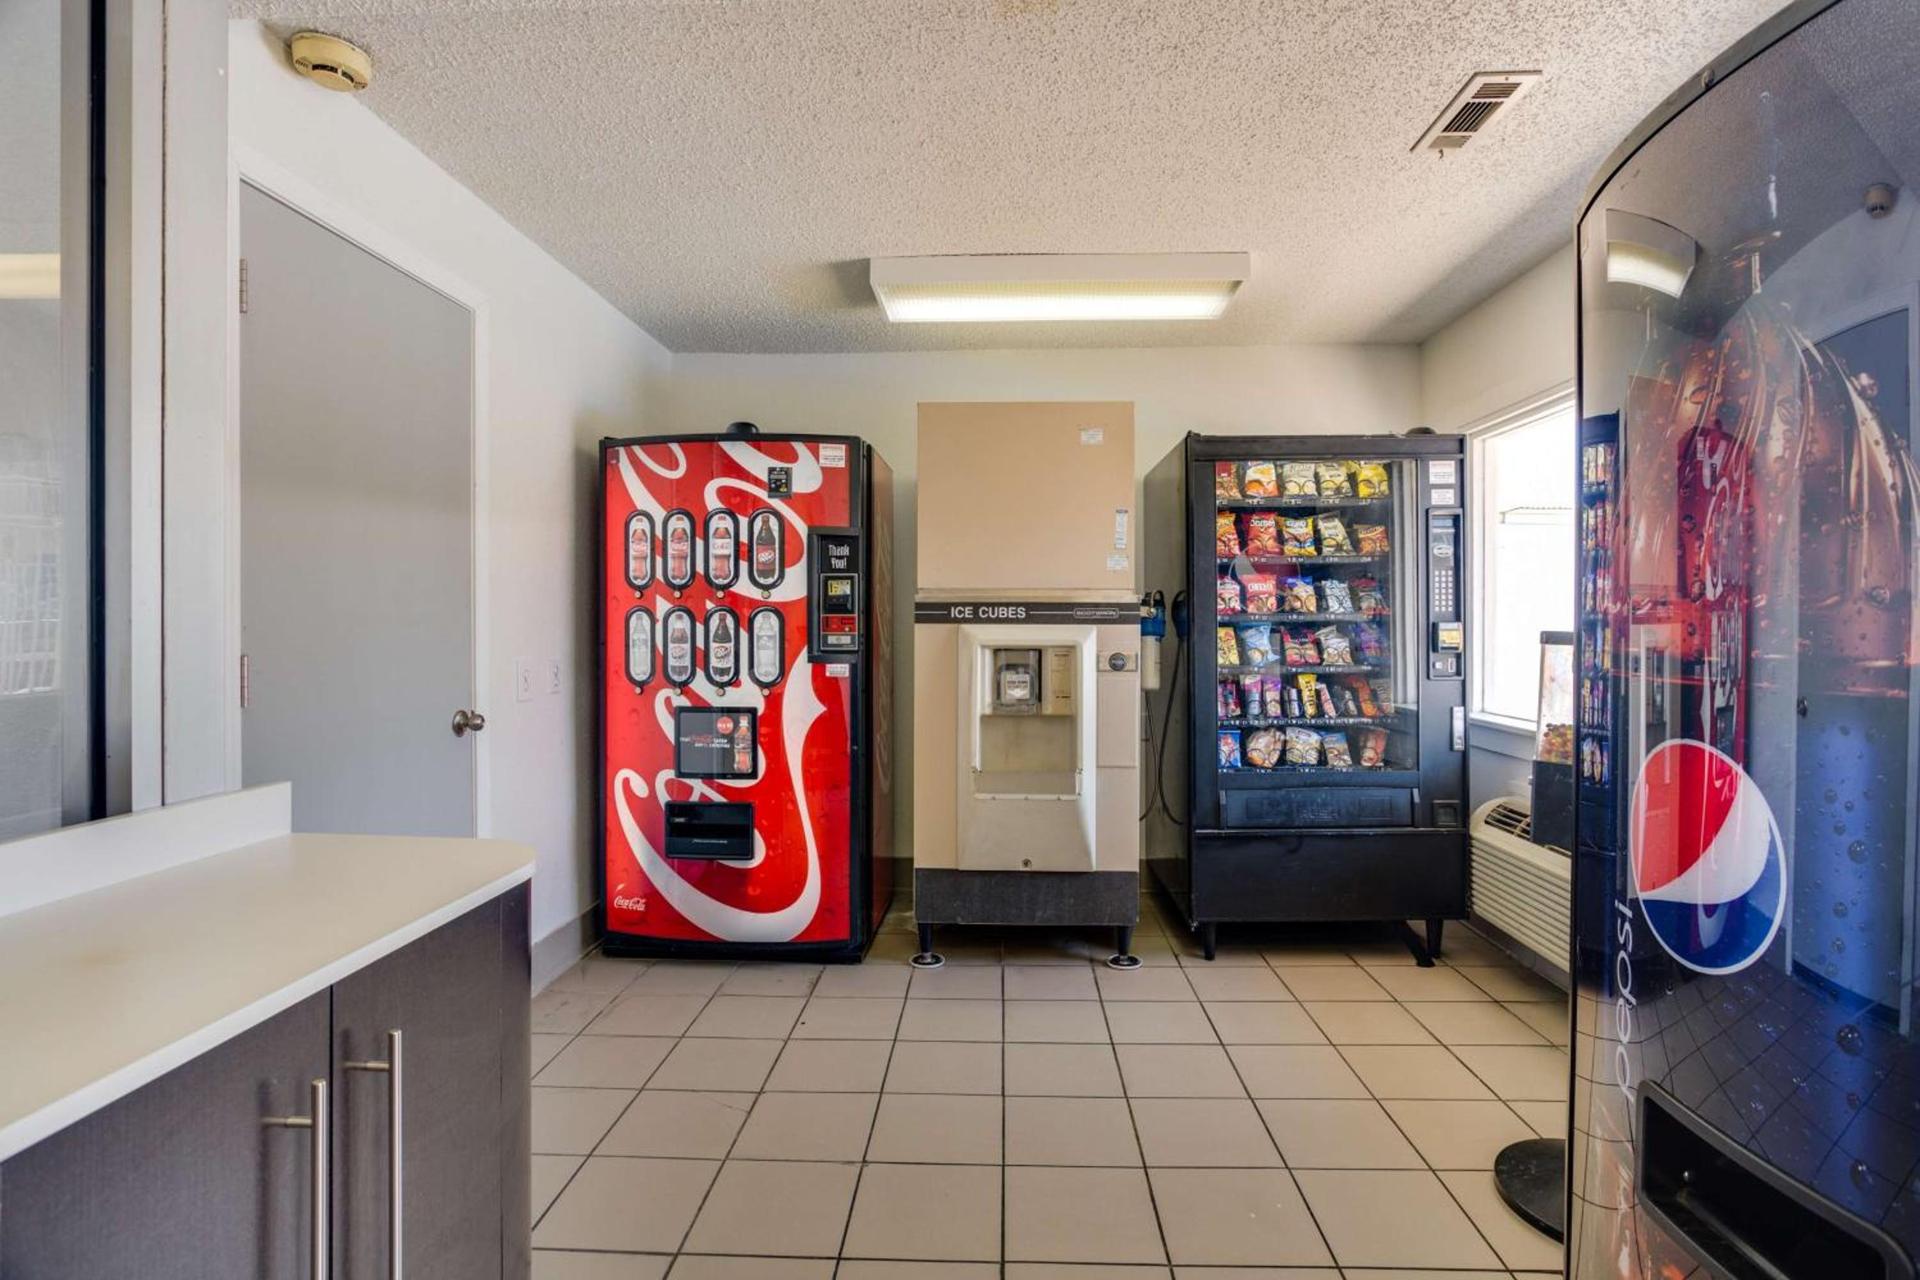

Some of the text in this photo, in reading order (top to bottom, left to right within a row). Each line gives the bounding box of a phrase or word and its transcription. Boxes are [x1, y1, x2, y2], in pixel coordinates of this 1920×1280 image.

[828, 544, 850, 557] Thank
[830, 557, 847, 569] You!
[951, 606, 1027, 619] ICE CUBES
[1614, 899, 1637, 1104] pepsi
